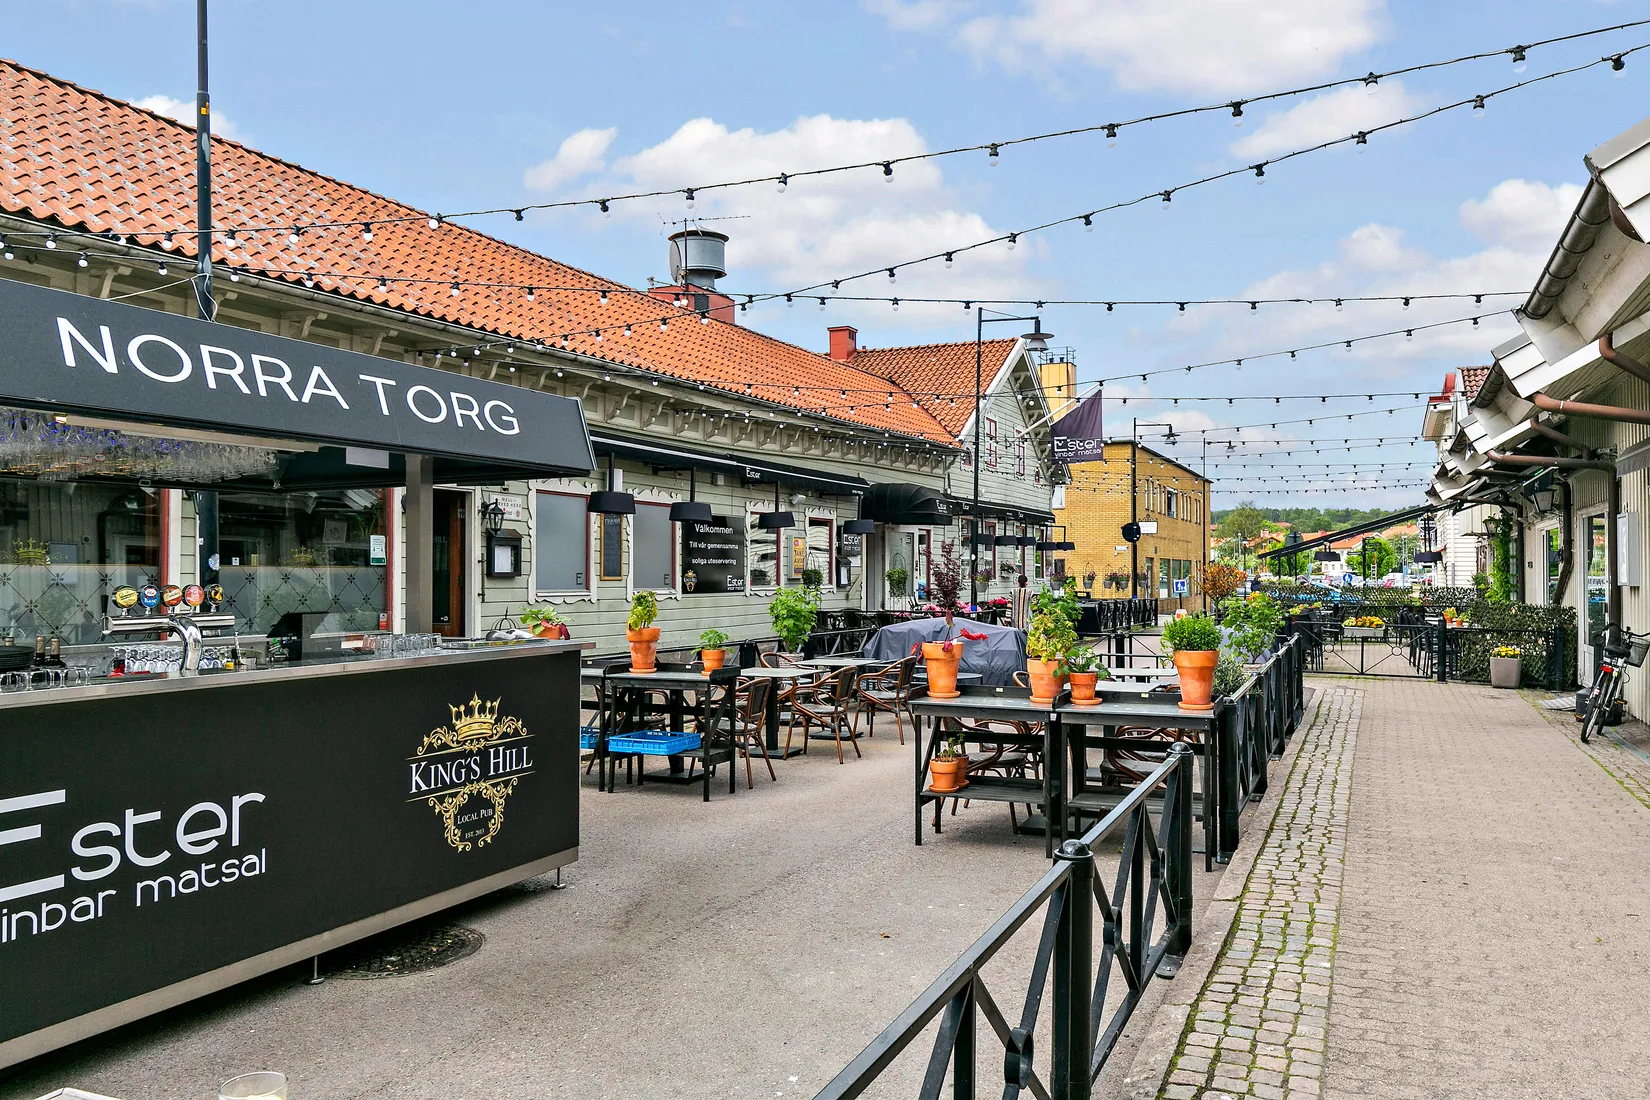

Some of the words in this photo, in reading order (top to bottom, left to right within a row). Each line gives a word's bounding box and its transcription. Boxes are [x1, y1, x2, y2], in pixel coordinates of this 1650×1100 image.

[57, 317, 350, 409] NORRA
[358, 375, 520, 435] TORG
[1054, 436, 1101, 452] Ester
[1078, 448, 1102, 456] matsal
[745, 467, 761, 479] Ester
[695, 523, 734, 534] Välkommen
[692, 557, 707, 565] soliga
[707, 558, 737, 566] uteservering
[727, 575, 744, 587] Ester
[488, 746, 533, 776] HILL
[457, 812, 479, 824] LOCAL
[480, 808, 493, 818] PUB
[0, 789, 265, 903] Ester
[137, 848, 266, 906] matsal
